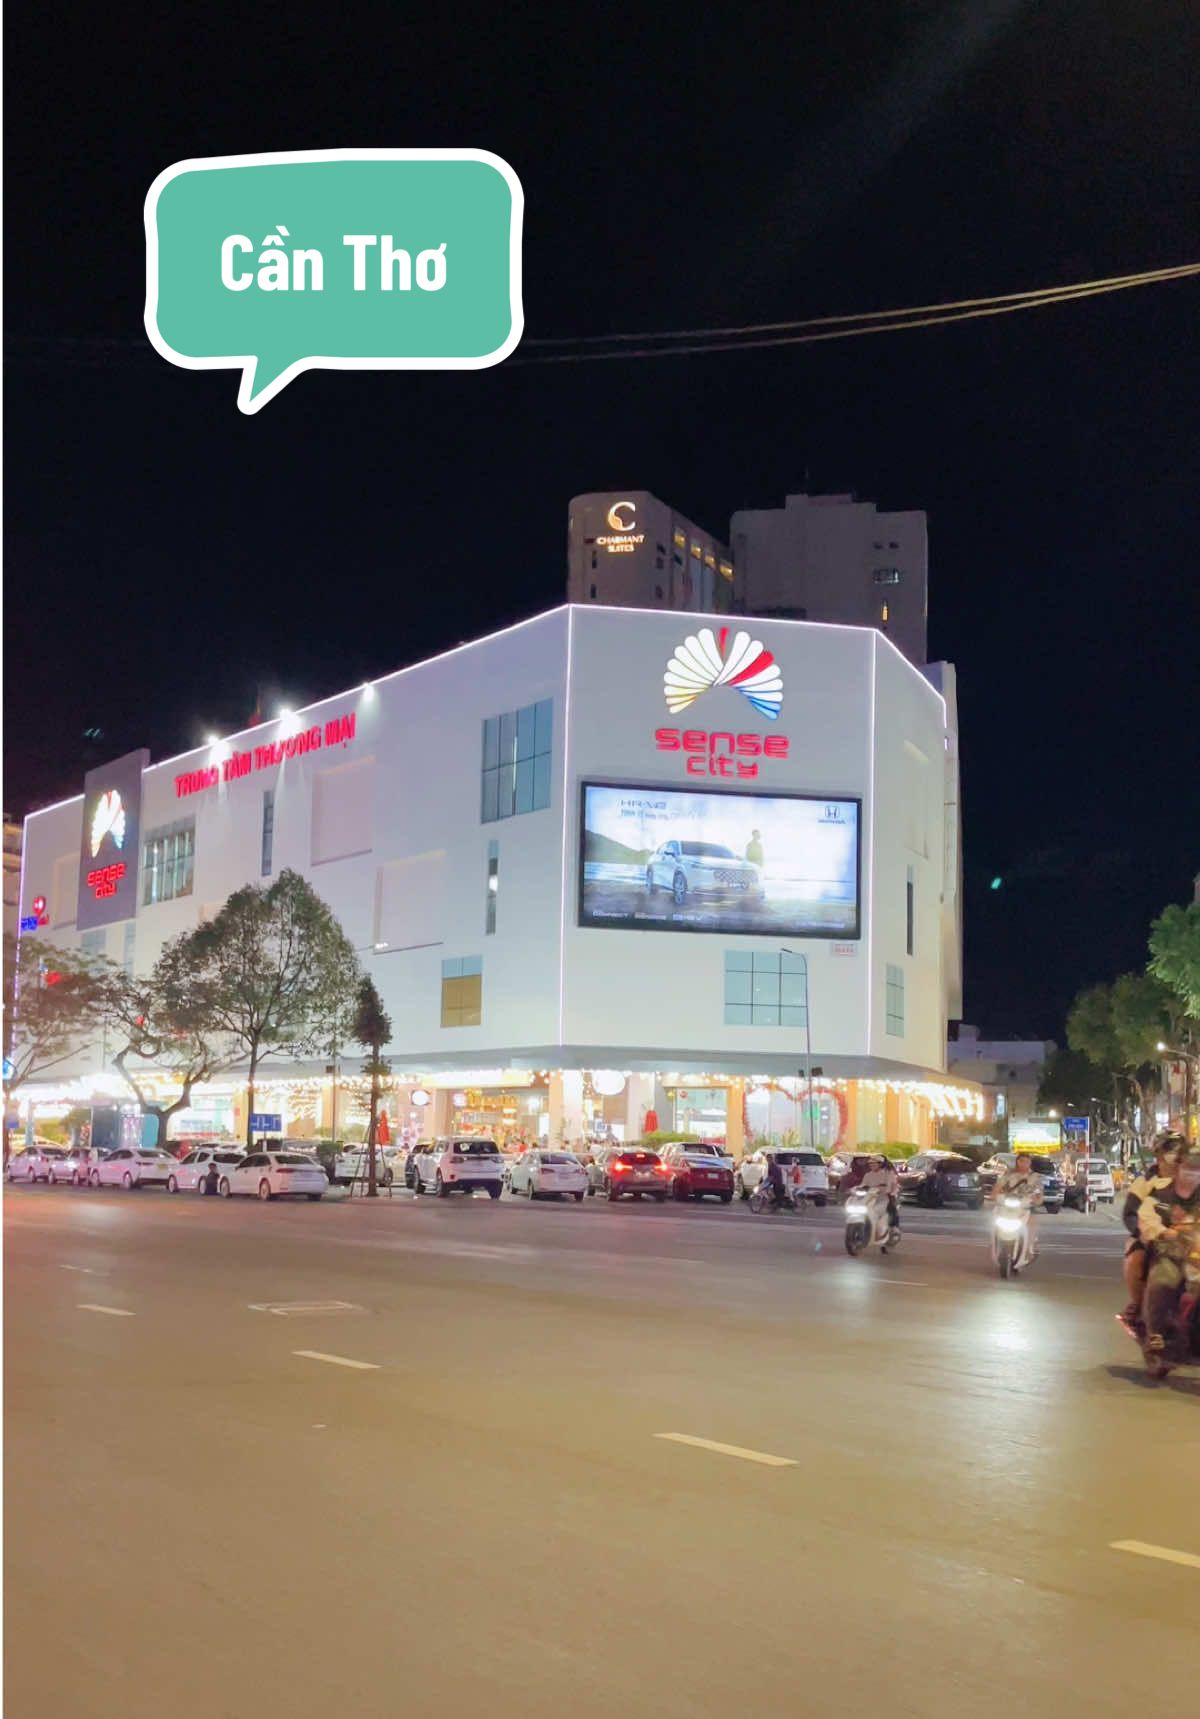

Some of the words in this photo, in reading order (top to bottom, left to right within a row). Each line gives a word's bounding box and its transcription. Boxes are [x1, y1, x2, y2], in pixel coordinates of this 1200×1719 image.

[174, 764, 219, 798] TRUNG
[254, 725, 322, 771] THƯƠNG
[325, 711, 357, 749] MẠI
[655, 728, 789, 759] sense
[687, 753, 758, 779] city
